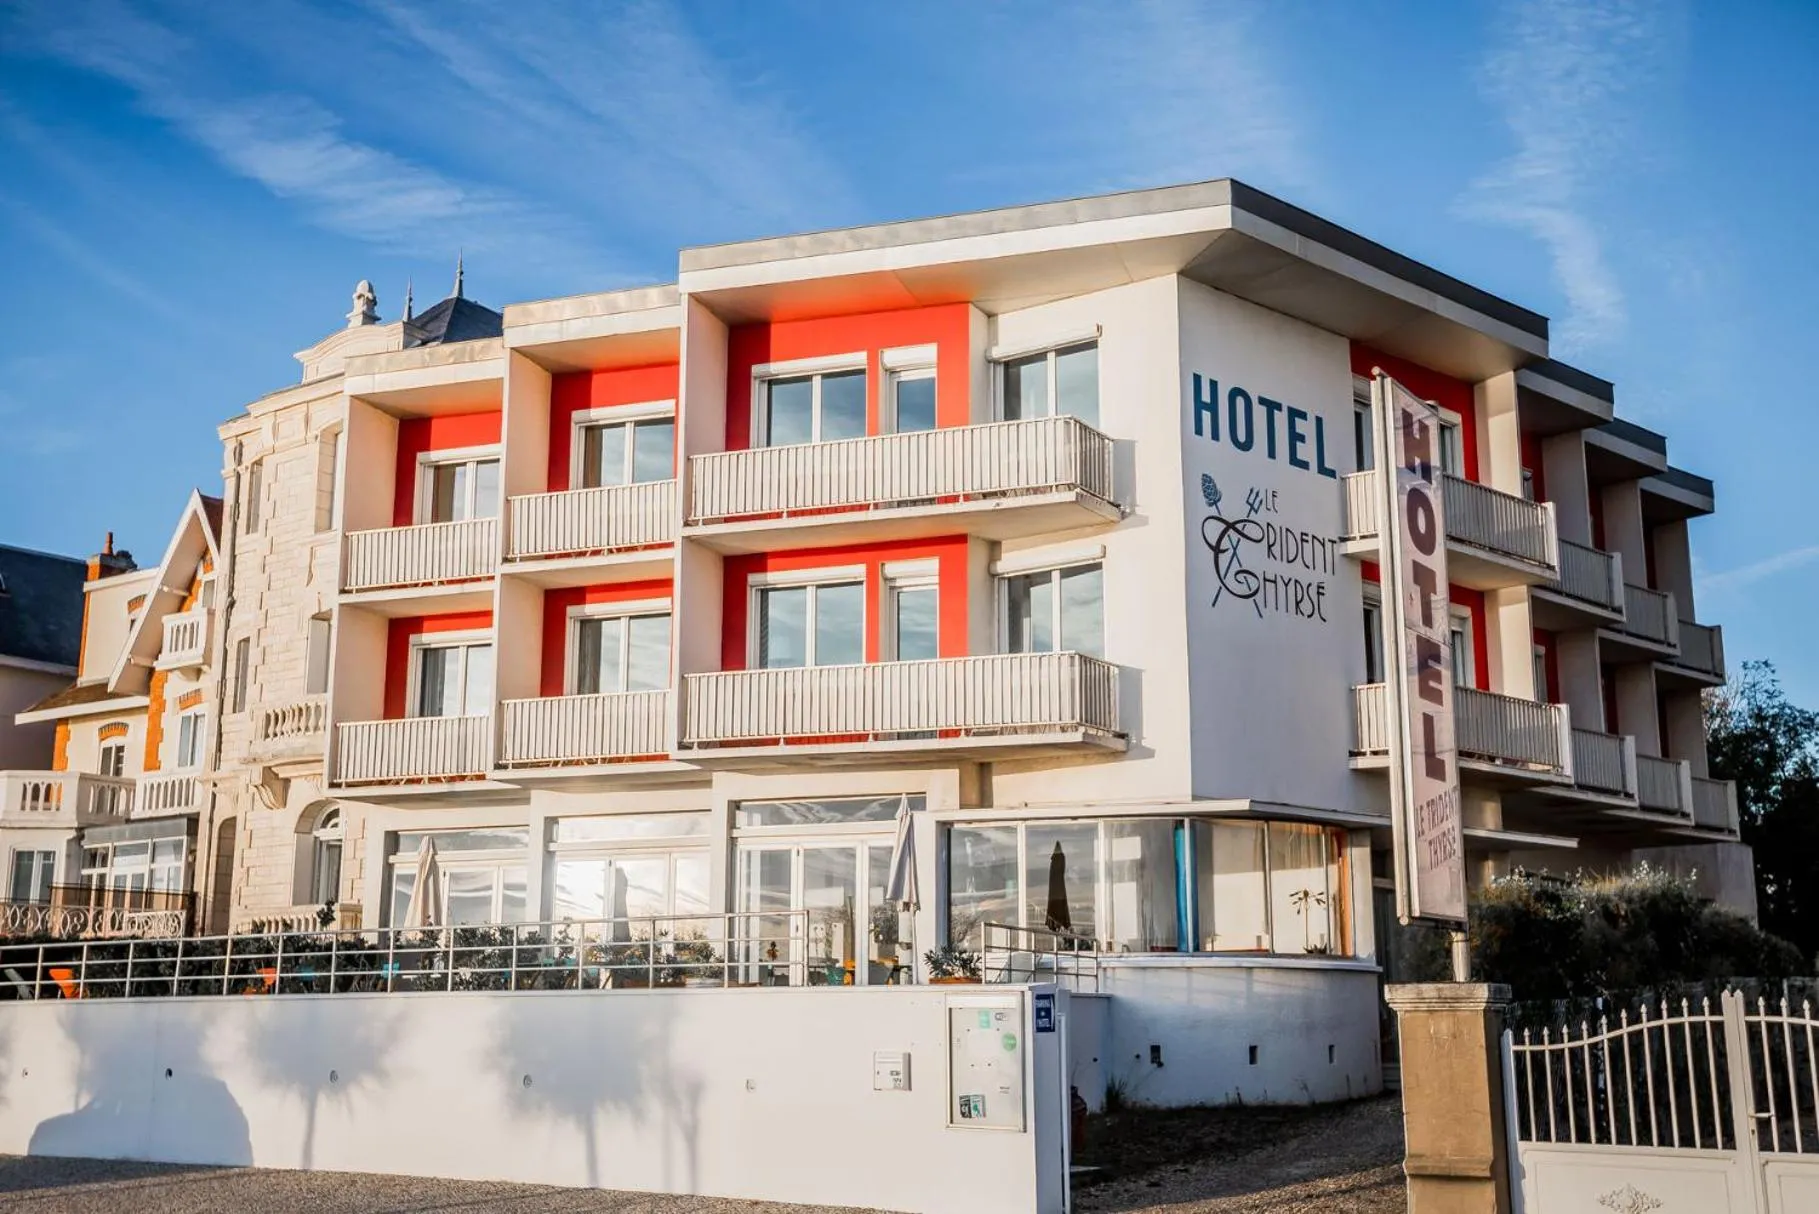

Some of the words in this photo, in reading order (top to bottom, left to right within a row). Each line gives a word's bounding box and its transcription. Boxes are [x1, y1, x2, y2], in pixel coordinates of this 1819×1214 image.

[1193, 372, 1337, 479] HOTEL
[1265, 488, 1279, 513] LE
[1402, 408, 1447, 783] HOTEL
[1415, 804, 1425, 837] LE
